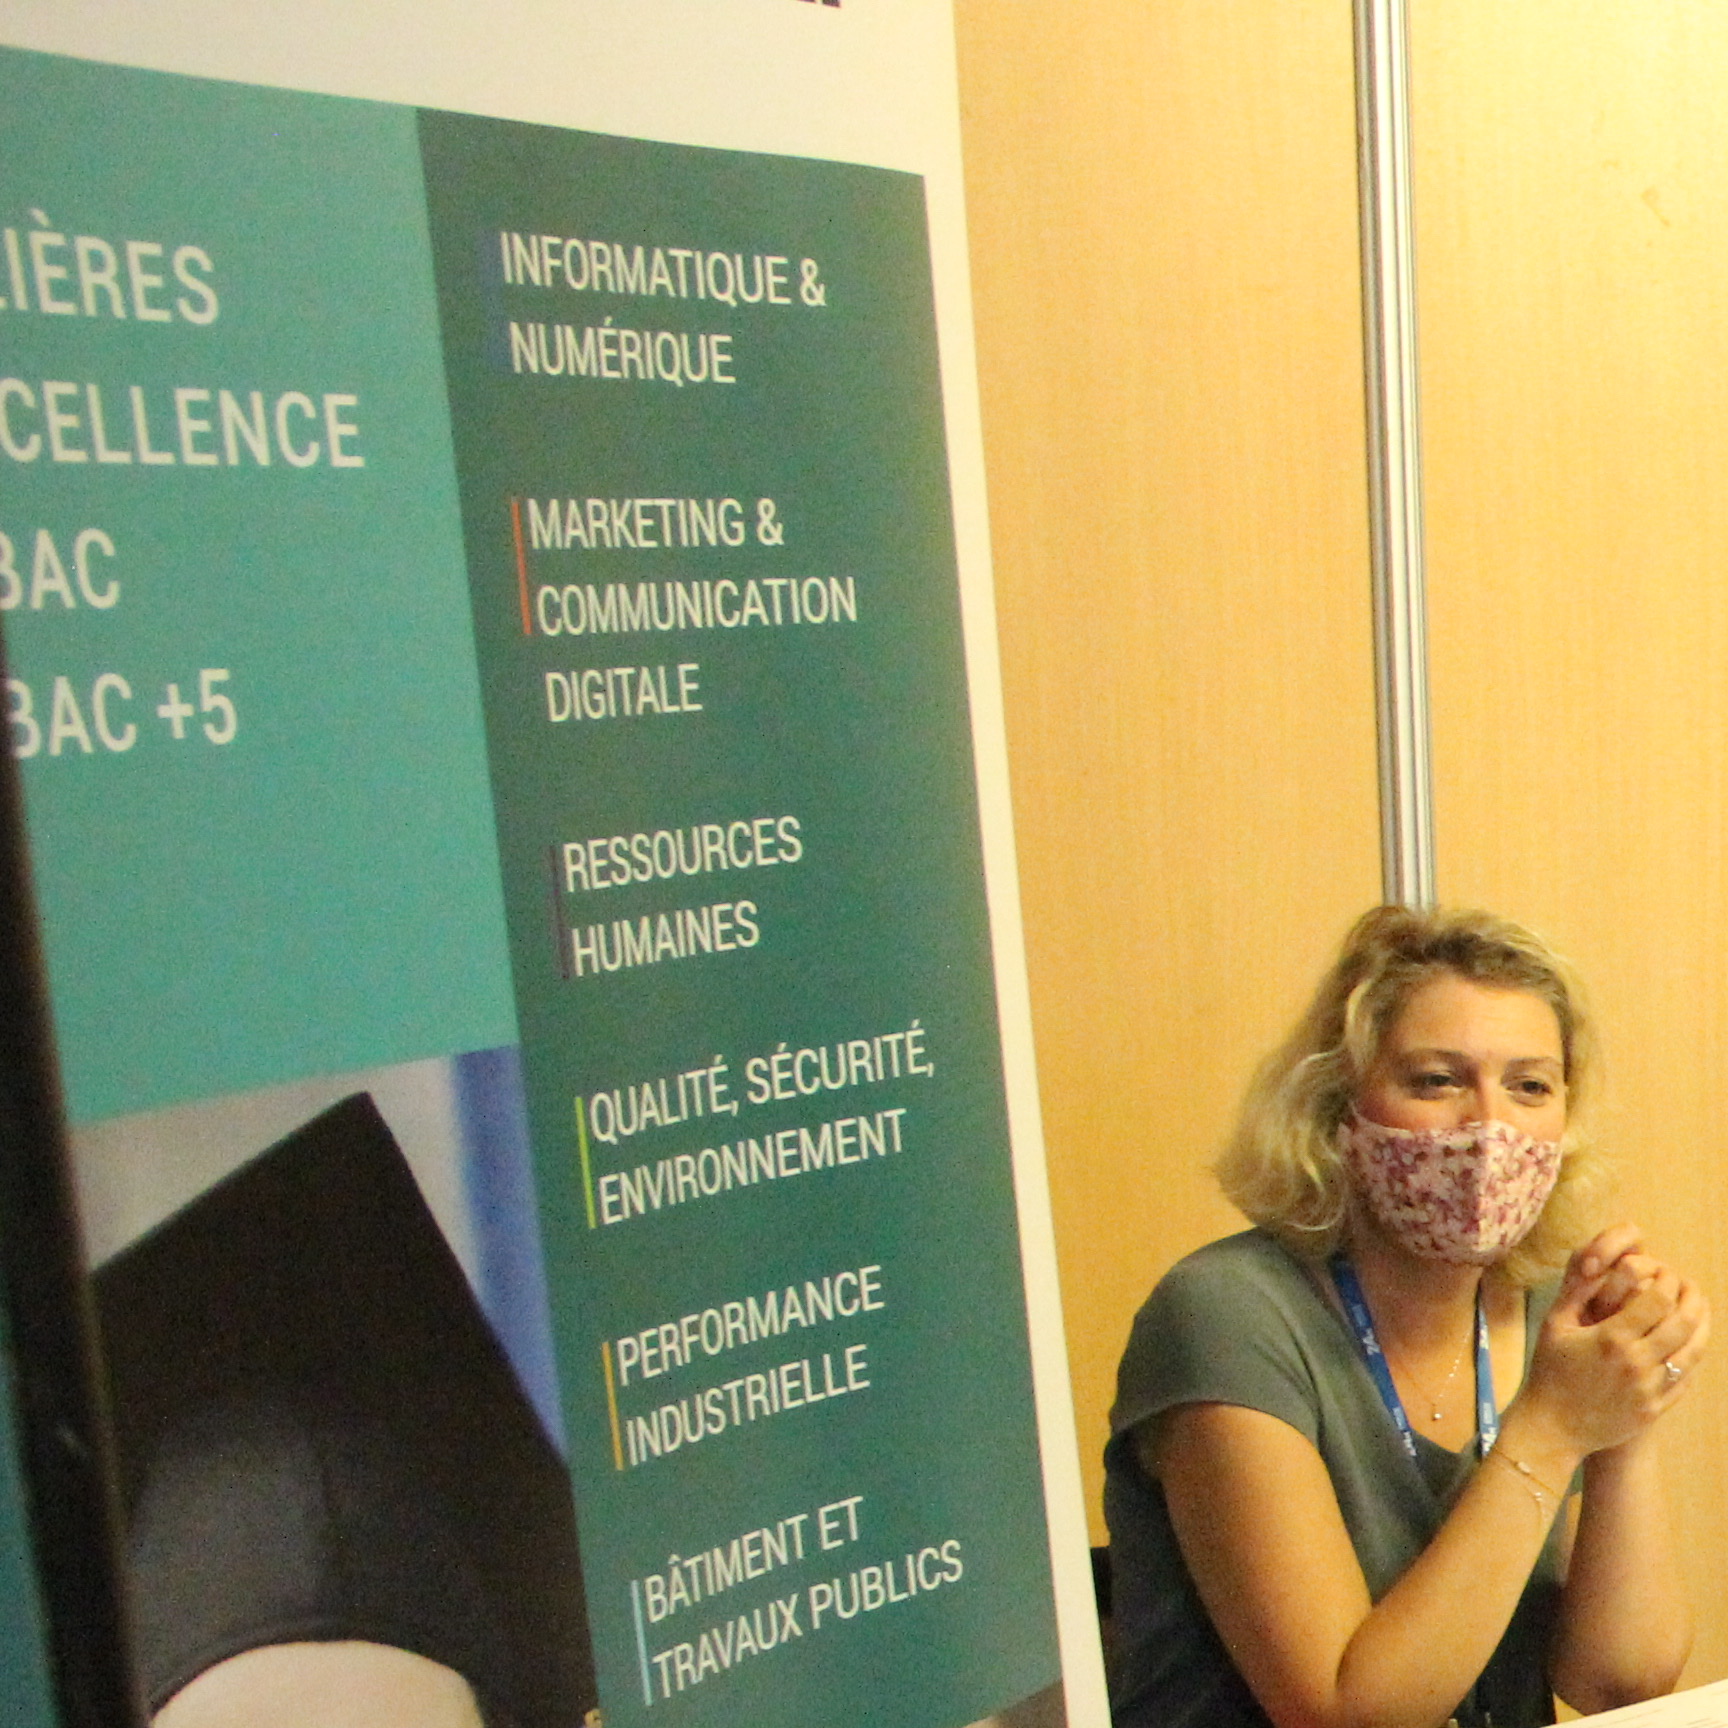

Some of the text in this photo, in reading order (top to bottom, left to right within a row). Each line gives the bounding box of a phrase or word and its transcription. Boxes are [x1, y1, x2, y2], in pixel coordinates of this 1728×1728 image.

[0, 208, 218, 326] IÈRES
[500, 231, 828, 308] INFORMATIQUE &
[509, 315, 737, 388] NUMÉRIQUE
[527, 498, 785, 550] MARKETING &
[537, 576, 858, 637] COMMUNICATION
[156, 667, 238, 746] +5
[545, 662, 703, 723] DIGITALE
[563, 815, 803, 893] RESSOURCES
[571, 900, 760, 977] HUMAINES
[590, 1018, 935, 1146] QUALITÉ, SÉCURITÉ,
[599, 1107, 908, 1226] ENVIRONNEMENT
[616, 1264, 886, 1387] PERFORMANCE
[626, 1344, 871, 1467] INDUSTRIELLE
[644, 1495, 864, 1624] BÂTIMENT ET
[652, 1539, 964, 1699] TRAVAUX PUBLICS
